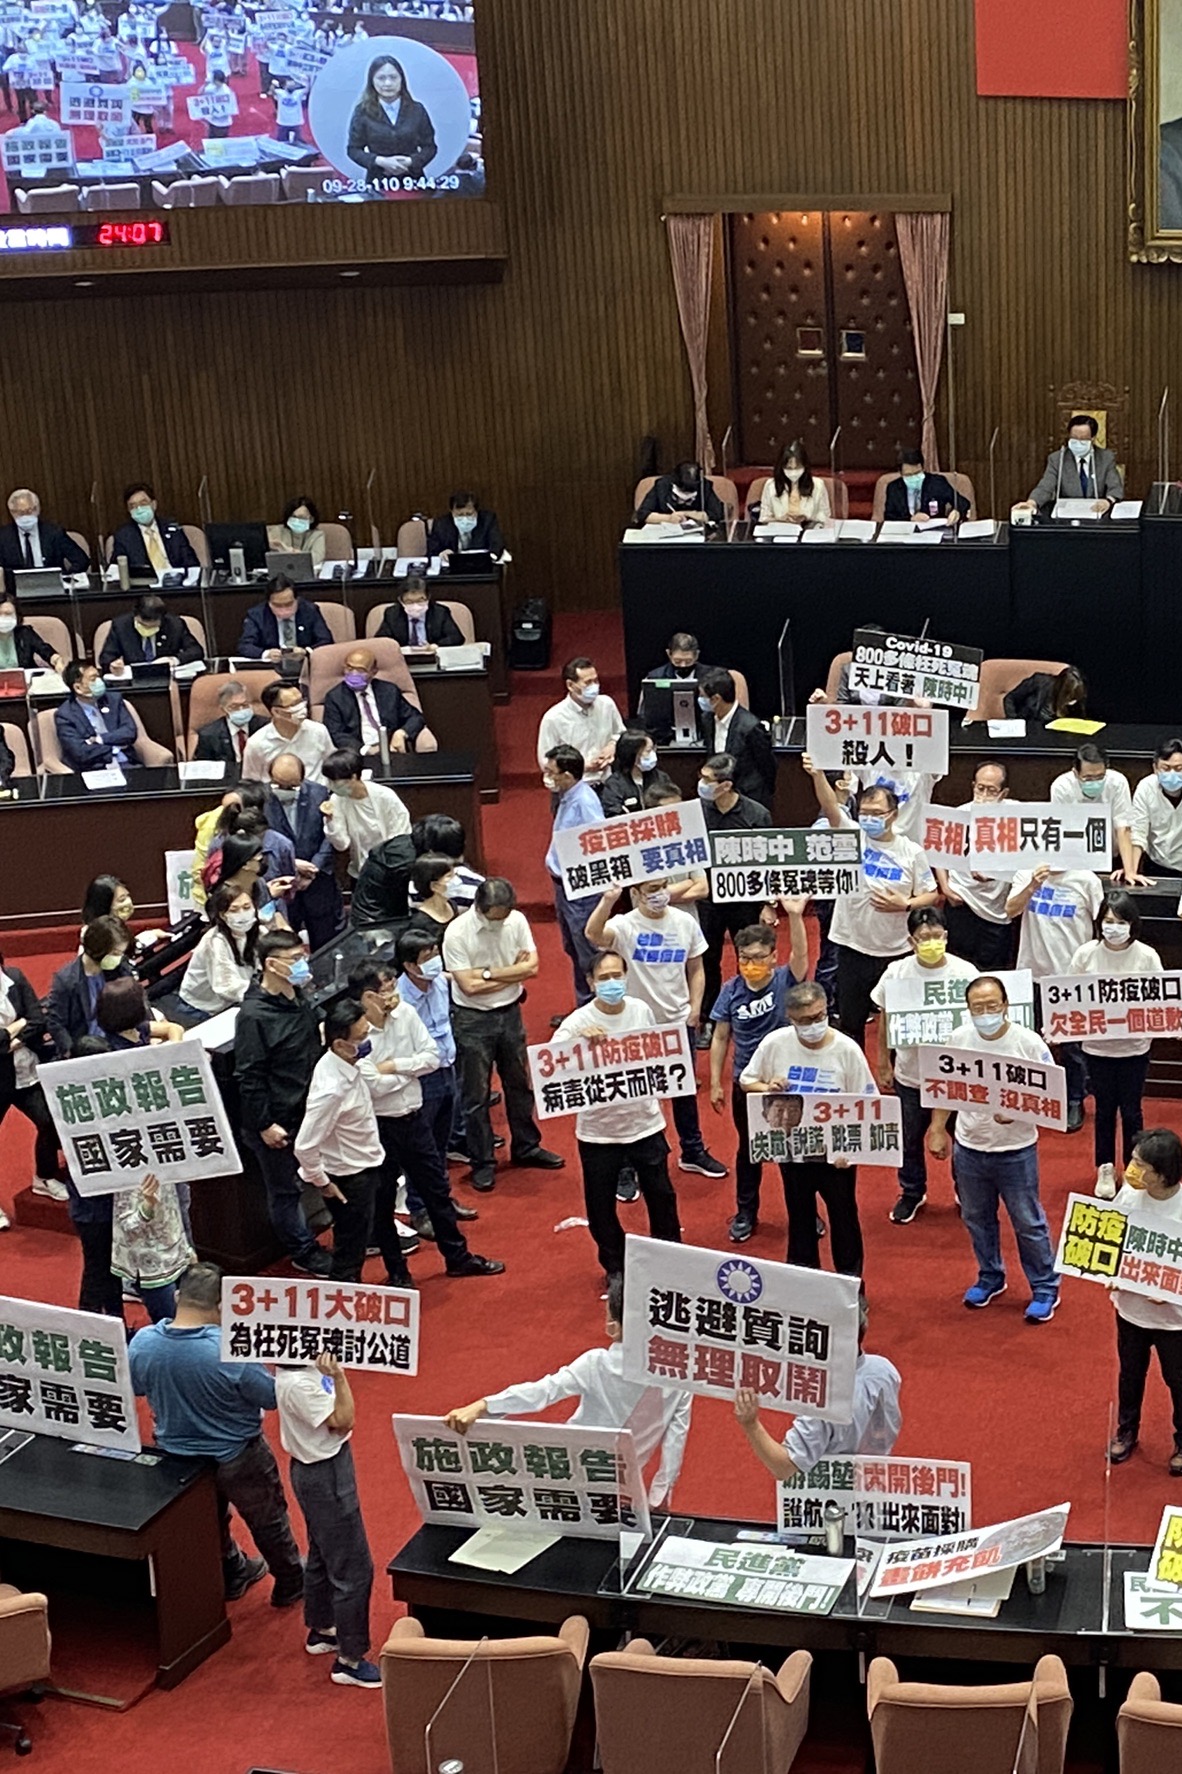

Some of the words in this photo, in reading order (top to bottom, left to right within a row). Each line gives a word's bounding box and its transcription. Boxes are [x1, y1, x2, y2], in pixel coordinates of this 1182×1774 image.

[322, 179, 400, 194] 09-28-110
[402, 175, 460, 192] 9:44:29
[100, 222, 163, 245] 24:07
[885, 637, 953, 658] Covid-19
[854, 666, 916, 695] 天上看著
[923, 676, 974, 705] 陳時中!
[825, 709, 932, 738] 3+11破口
[842, 740, 914, 768] 殺人!
[578, 811, 682, 856] 疫苗採購
[714, 834, 795, 864] 陳時中
[805, 834, 860, 863] 范雲
[923, 817, 970, 857] 真相
[974, 817, 1107, 854] 真相只有一個
[566, 854, 633, 892] 破黑箱
[641, 838, 709, 874] 要真相
[923, 979, 969, 1006] 民進
[1047, 977, 1182, 1004] 3+11防疫破口
[537, 1029, 684, 1078] 3+11防疫破口
[937, 1054, 1048, 1090] 3+11破口
[56, 1065, 207, 1126] 施政報告
[541, 1063, 688, 1113] 病毒從天而降?
[924, 1078, 991, 1106] 不調查
[999, 1087, 1063, 1122] 沒真相
[812, 1099, 883, 1123] 3+11
[72, 1115, 226, 1176] 國家需要
[1069, 1200, 1128, 1245] 防疫
[1062, 1235, 1121, 1277] 破口
[230, 1283, 411, 1328] 3+11大破口
[649, 1287, 830, 1362] 逃避質詢
[229, 1322, 411, 1371] 為枉死冤魂討公道
[647, 1334, 828, 1409] 無理取鬧
[412, 1436, 628, 1487] 施政報告
[424, 1479, 640, 1530] 國家需要
[703, 1548, 806, 1576] 民進黨
